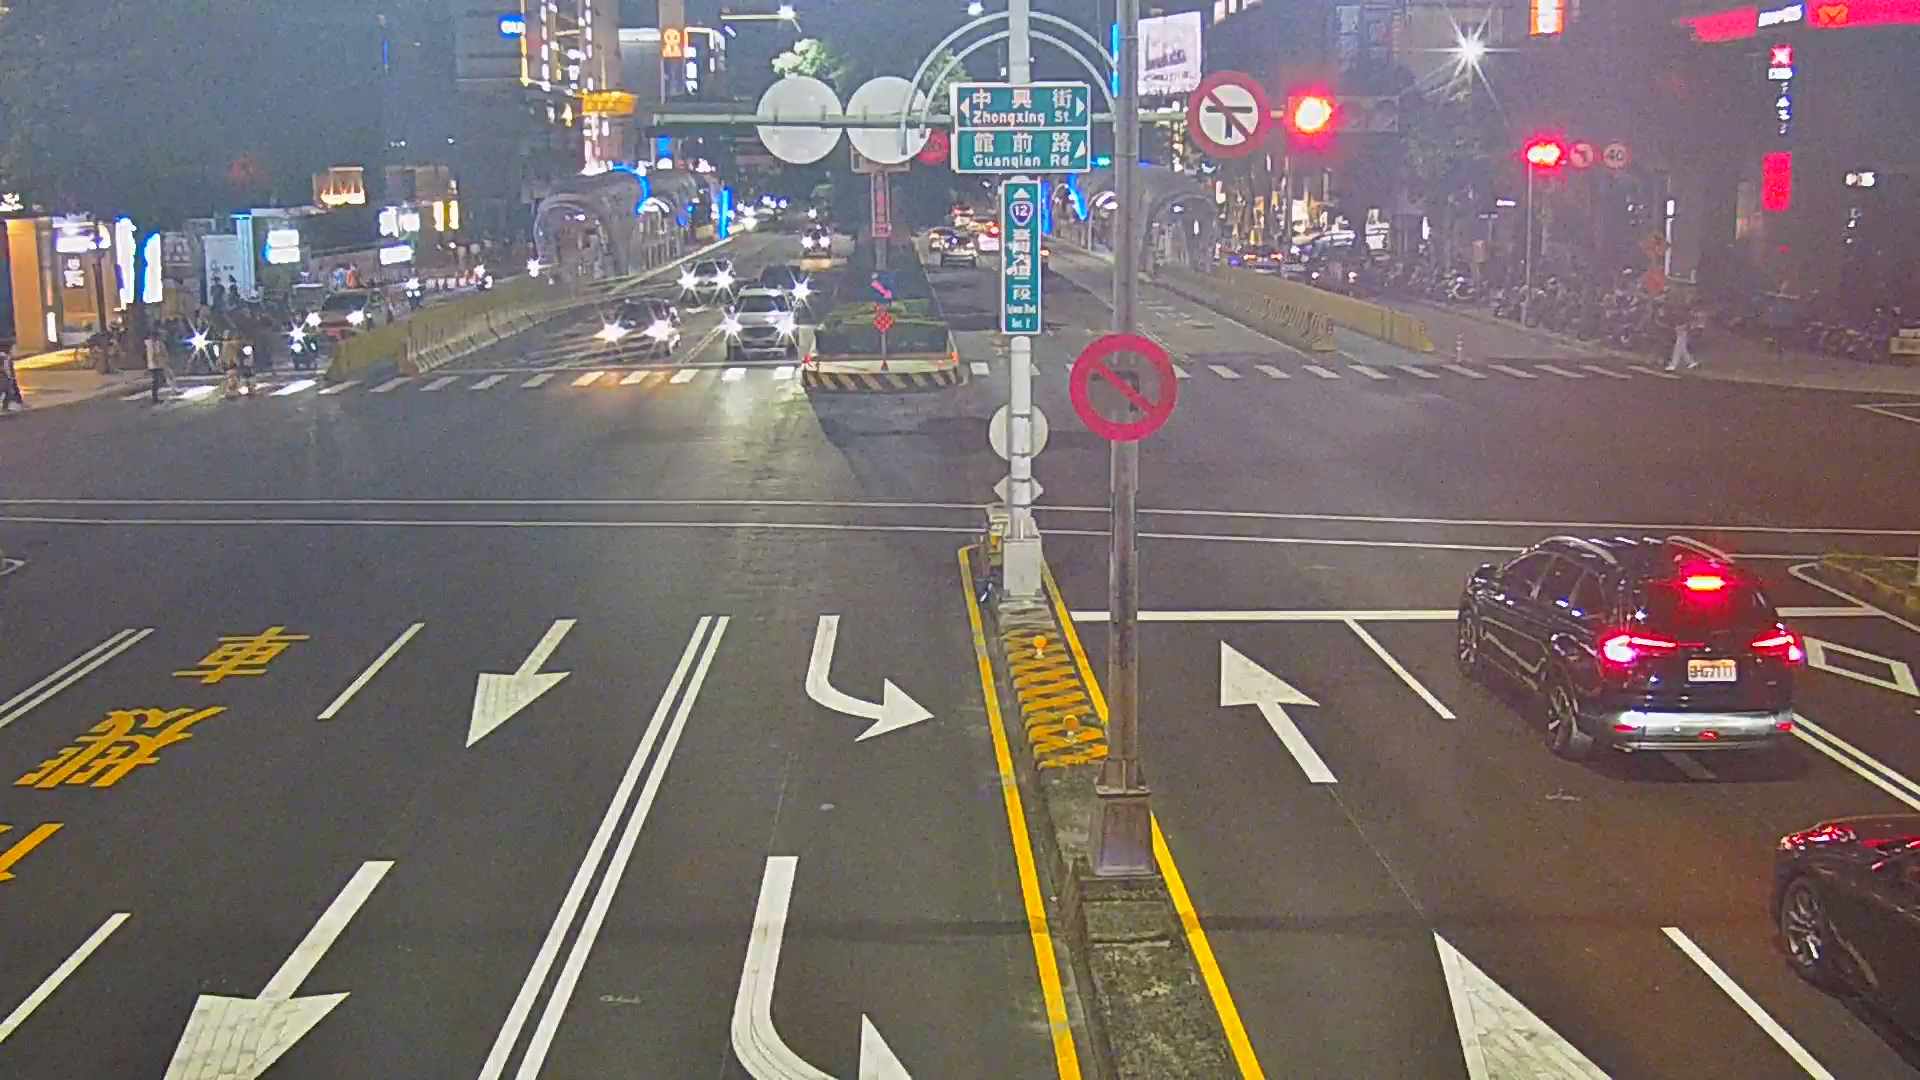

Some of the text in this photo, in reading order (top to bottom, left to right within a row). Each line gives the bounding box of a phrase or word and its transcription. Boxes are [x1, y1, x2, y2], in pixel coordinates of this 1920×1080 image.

[972, 88, 1072, 109] 中興街
[972, 110, 1045, 127] Zhongxing
[974, 132, 1072, 153] 館前路
[973, 154, 1041, 169] Guanqian
[1014, 205, 1029, 216] 12
